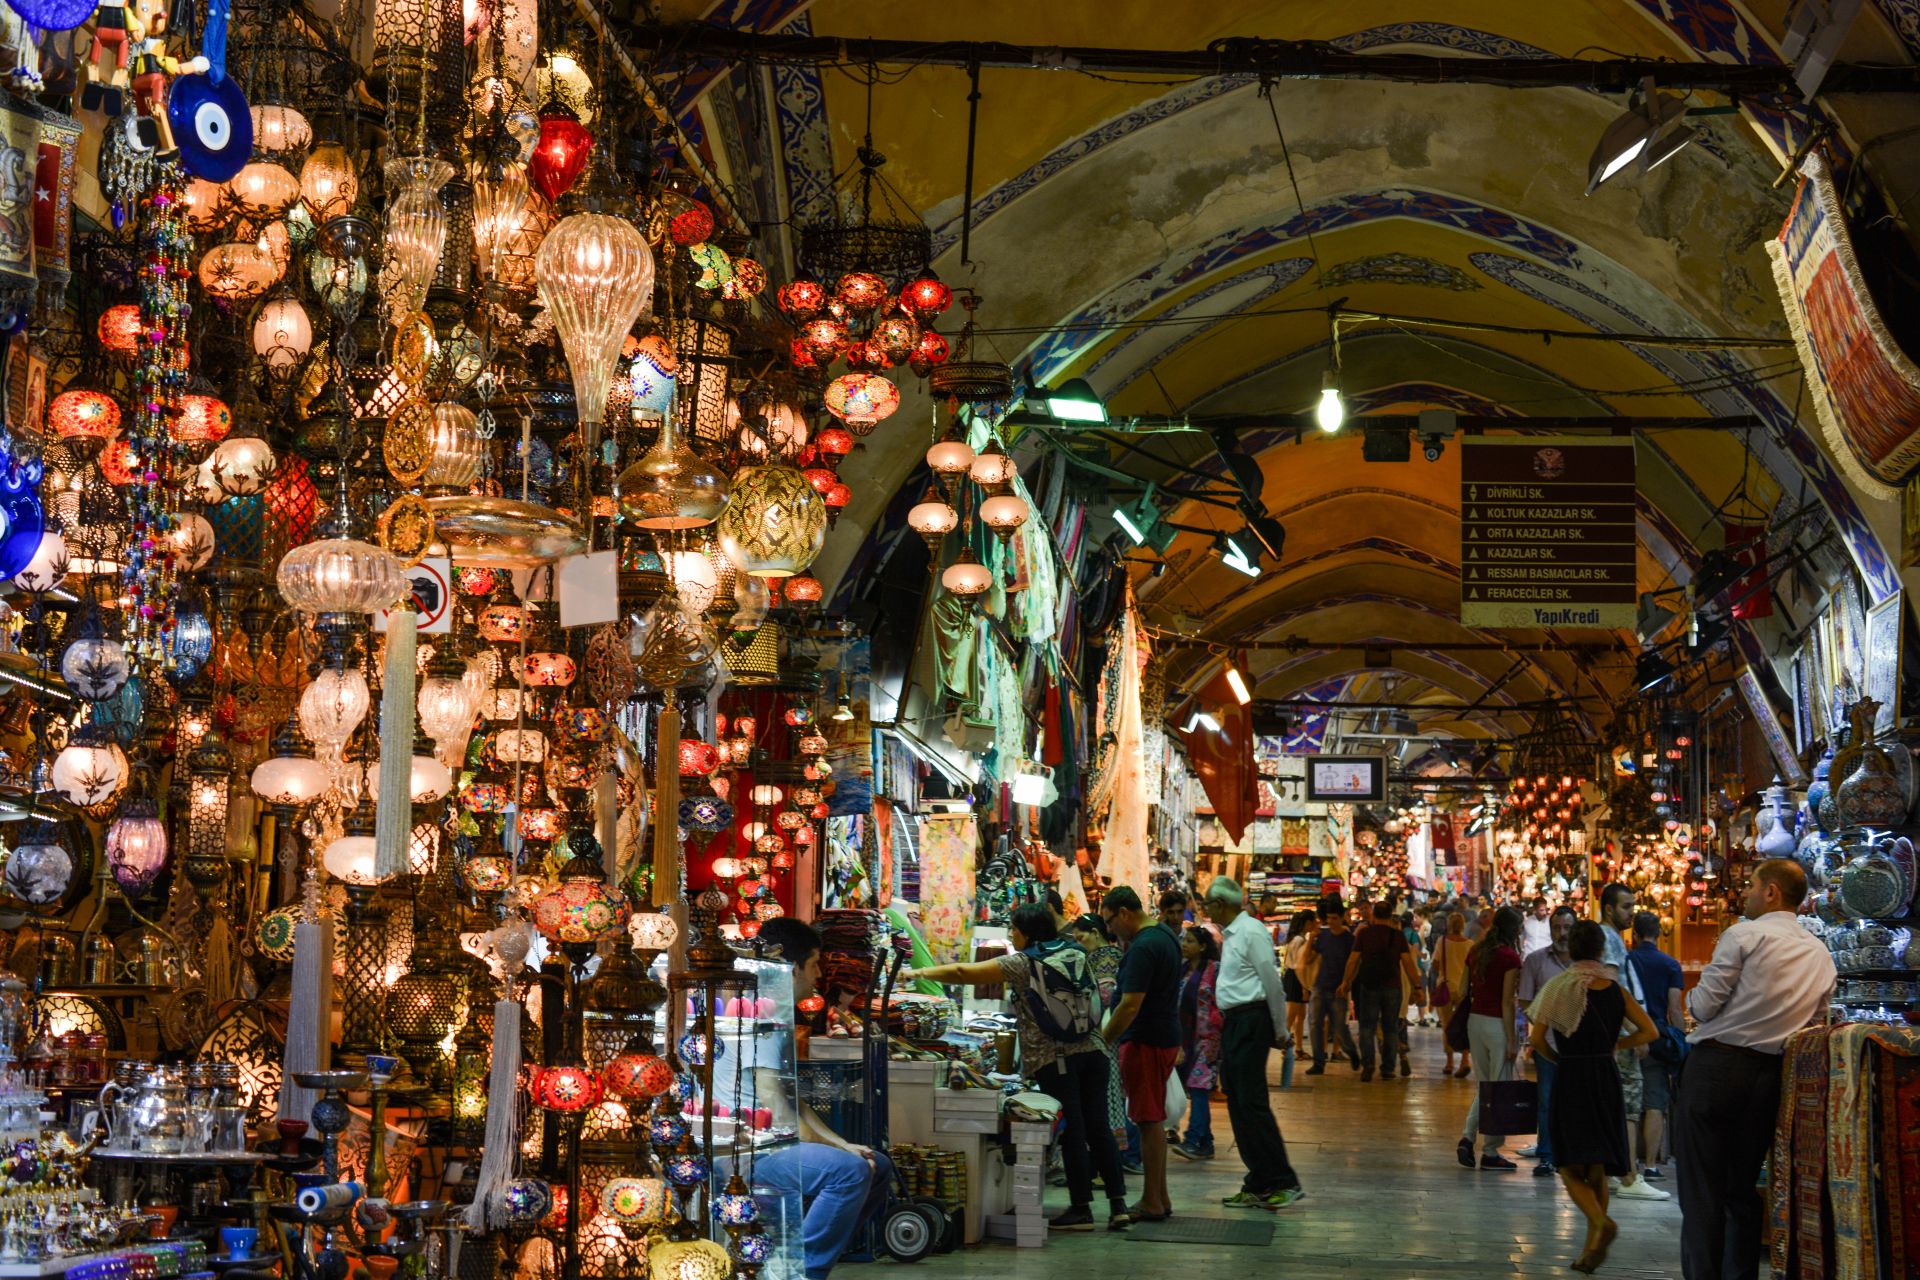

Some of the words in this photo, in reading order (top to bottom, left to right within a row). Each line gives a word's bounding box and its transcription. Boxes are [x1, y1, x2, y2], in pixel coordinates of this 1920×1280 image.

[1487, 486, 1526, 499] DİVRİKLİ
[1529, 488, 1545, 499] SK.
[1487, 508, 1526, 519] KOLTUK
[1528, 508, 1579, 519] KAZAZLAR
[1580, 508, 1597, 519] SK.
[1487, 528, 1514, 539] ORTA
[1516, 528, 1567, 539] KAZAZLAR
[1568, 528, 1585, 539] SK.
[1487, 548, 1538, 559] KAZAZLAR
[1540, 548, 1556, 559] SK.
[1487, 568, 1527, 579] RESSAM
[1529, 568, 1592, 579] BASMACILAR
[1593, 568, 1610, 579] SK.
[1487, 586, 1554, 599] FERACECİLER
[1555, 588, 1572, 599] SK.
